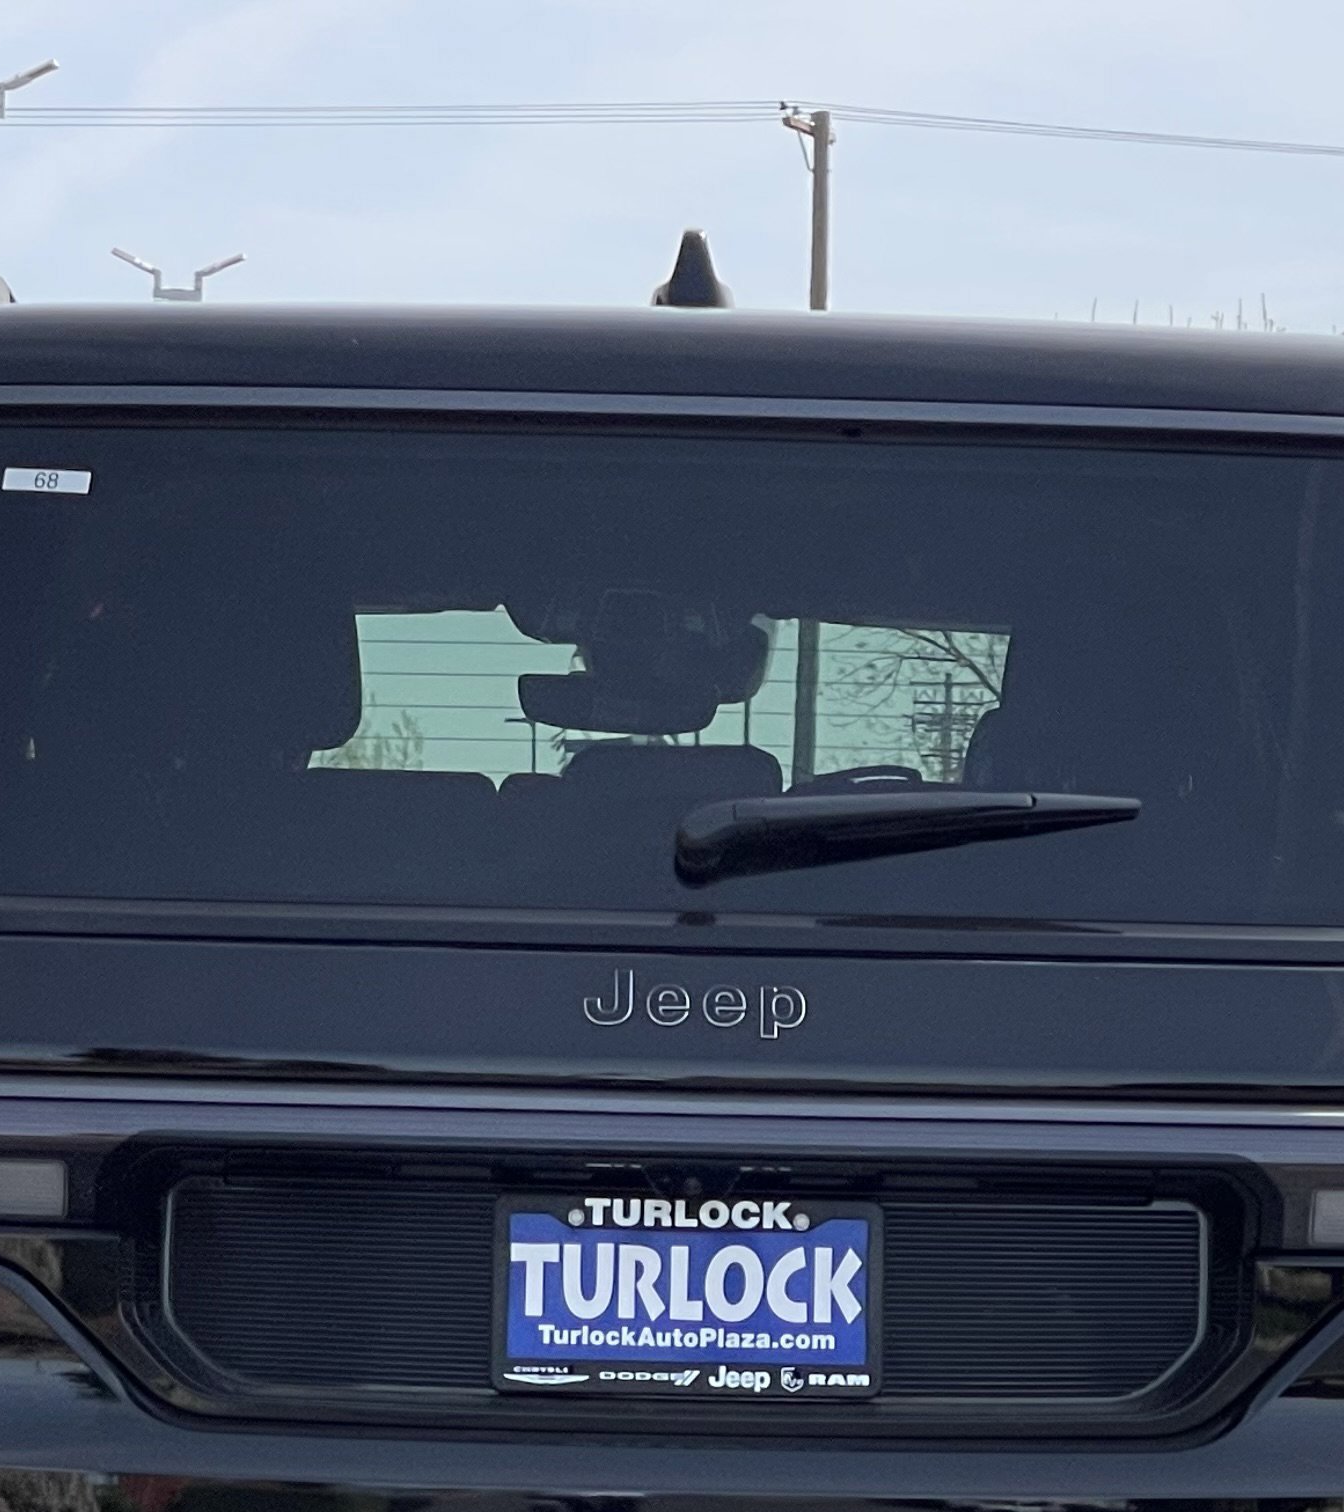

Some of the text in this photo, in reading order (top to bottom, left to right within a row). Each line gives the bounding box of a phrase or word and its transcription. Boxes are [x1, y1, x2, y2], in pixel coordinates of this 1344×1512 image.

[34, 471, 59, 489] 68
[583, 968, 807, 1039] Jeep
[584, 1197, 792, 1230] TURLOCK
[510, 1242, 863, 1325] TURLOCK
[538, 1324, 836, 1350] TurlockAutoPlaza.com
[708, 1365, 771, 1393] Jeep
[808, 1373, 870, 1387] RAM
